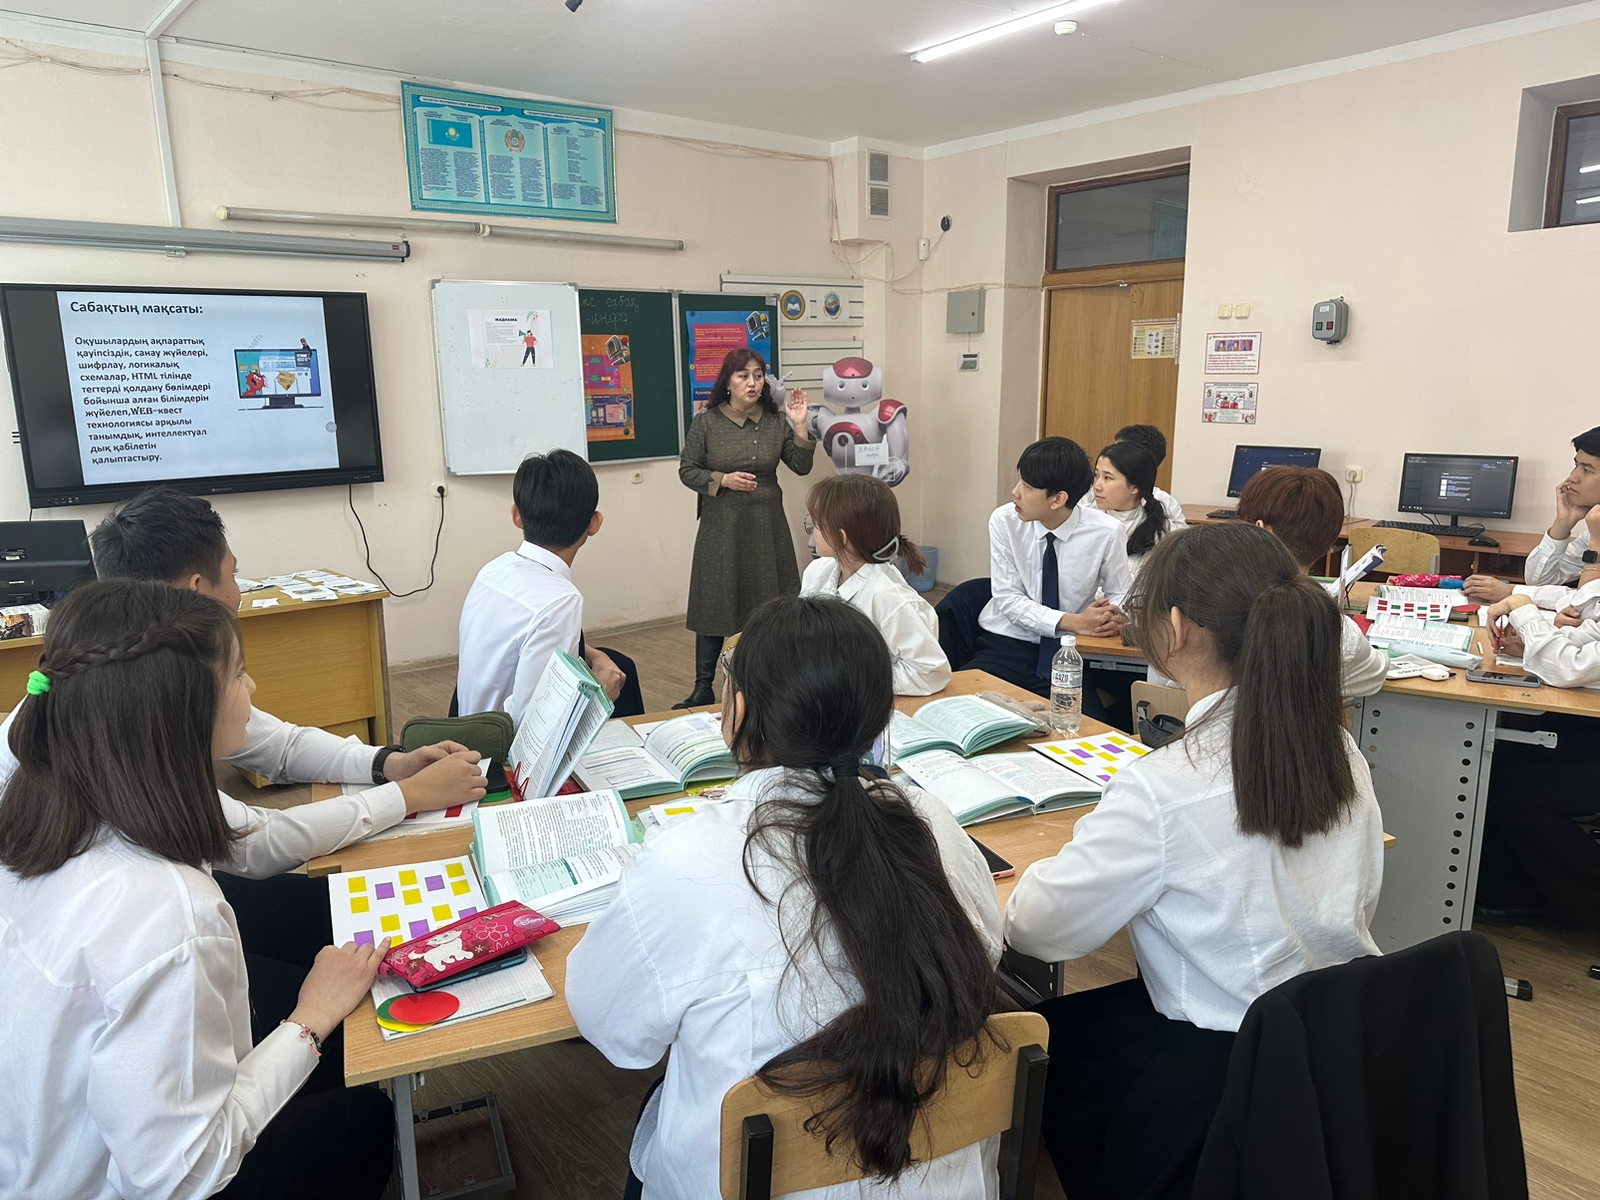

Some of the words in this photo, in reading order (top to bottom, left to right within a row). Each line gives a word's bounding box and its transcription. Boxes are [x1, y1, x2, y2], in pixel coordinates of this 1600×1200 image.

[70, 301, 140, 315] Сабақтың
[142, 305, 203, 316] мақсаты:
[75, 337, 149, 346] Оқушылардың
[77, 349, 132, 358] қауіпсіздік,
[134, 350, 161, 358] санау
[163, 348, 208, 358] жүйелері,
[78, 361, 126, 370] шифрлау,
[128, 361, 180, 369] логикалық
[80, 374, 129, 382] схемалар,
[160, 371, 192, 381] тілінде
[82, 385, 121, 394] тегтерді
[123, 385, 163, 393] қолдану
[165, 383, 211, 392] бөлімдері
[83, 396, 130, 405] бойынша
[160, 394, 209, 403] білімдерін
[87, 420, 153, 429] технологиясы
[155, 418, 192, 427] арқылы
[88, 433, 143, 441] танымдық,
[145, 429, 207, 438] интеллектуал
[90, 445, 111, 454] дық
[113, 442, 157, 452] қабілетін
[92, 454, 162, 465] қалыптастыру.
